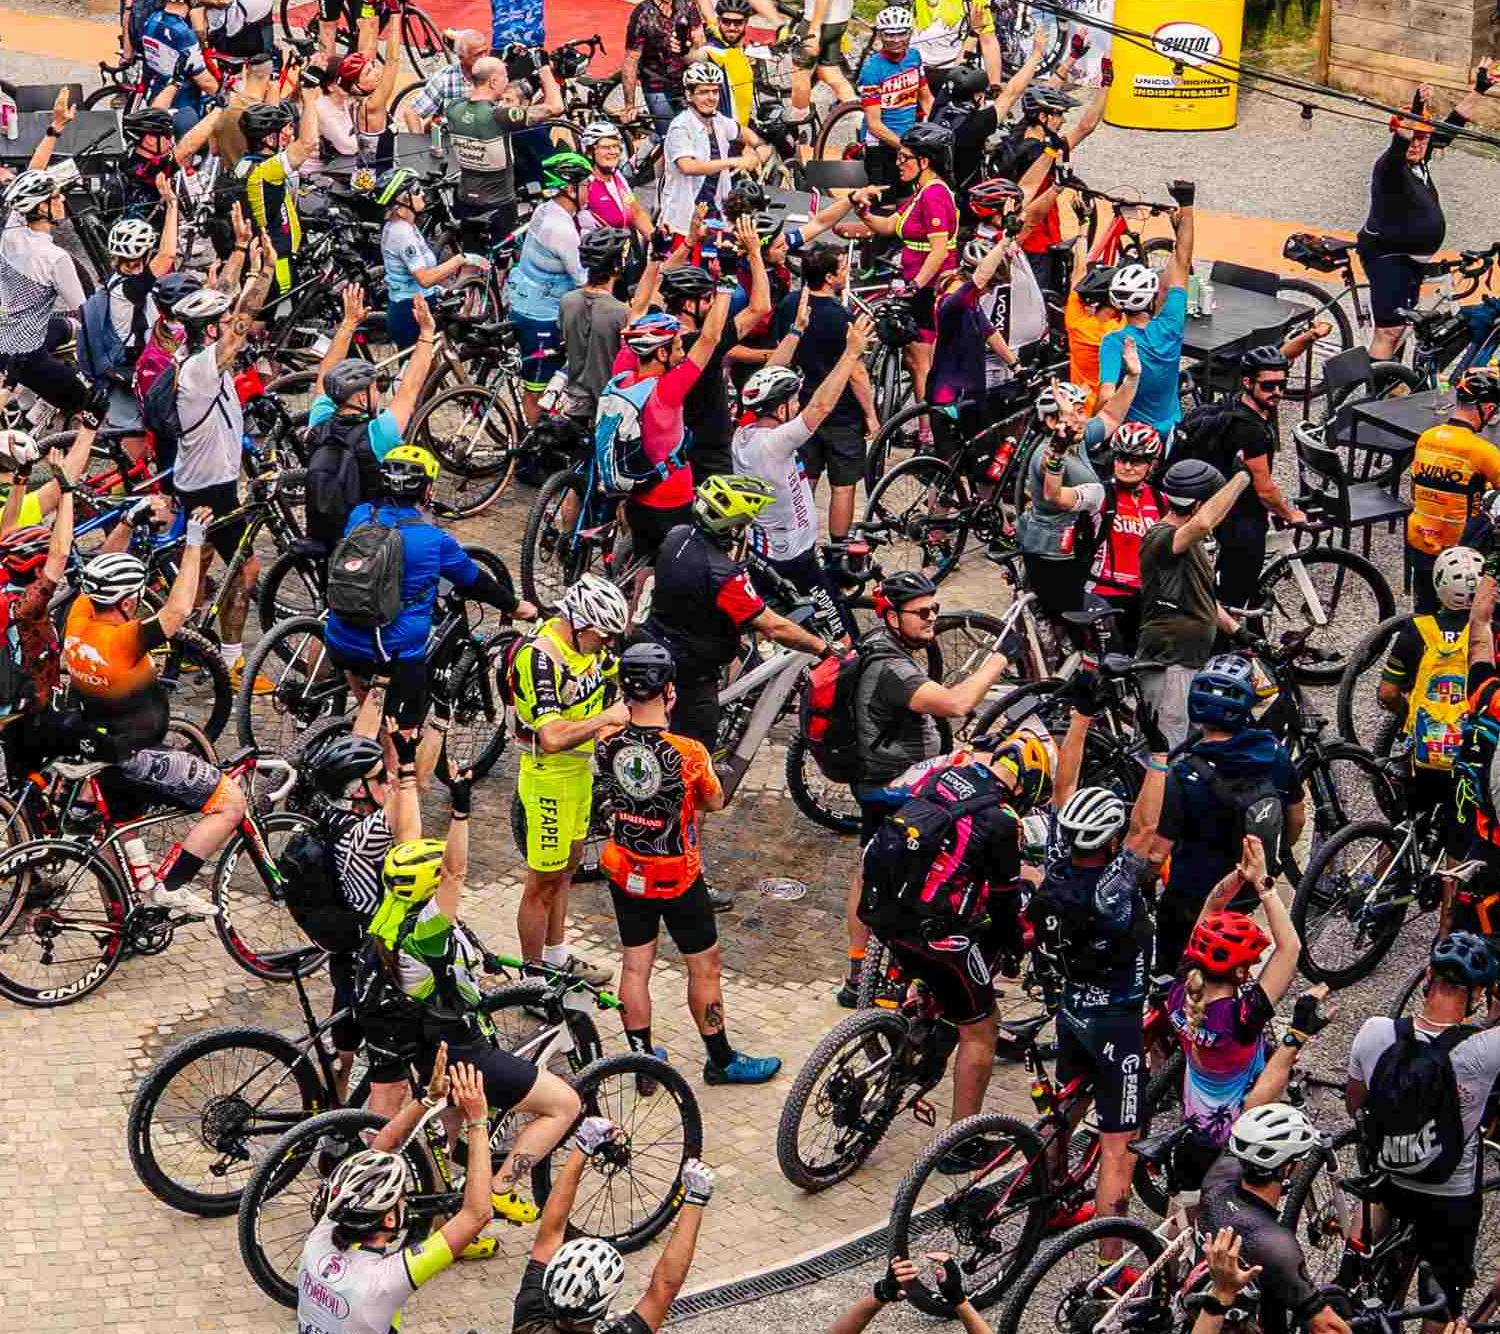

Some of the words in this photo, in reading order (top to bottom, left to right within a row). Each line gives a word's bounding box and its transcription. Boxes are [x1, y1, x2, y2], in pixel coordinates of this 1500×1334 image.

[1133, 88, 1230, 99] INDISPENSABILE
[536, 795, 558, 851] EFAPEL
[1378, 1120, 1443, 1169] NIKE
